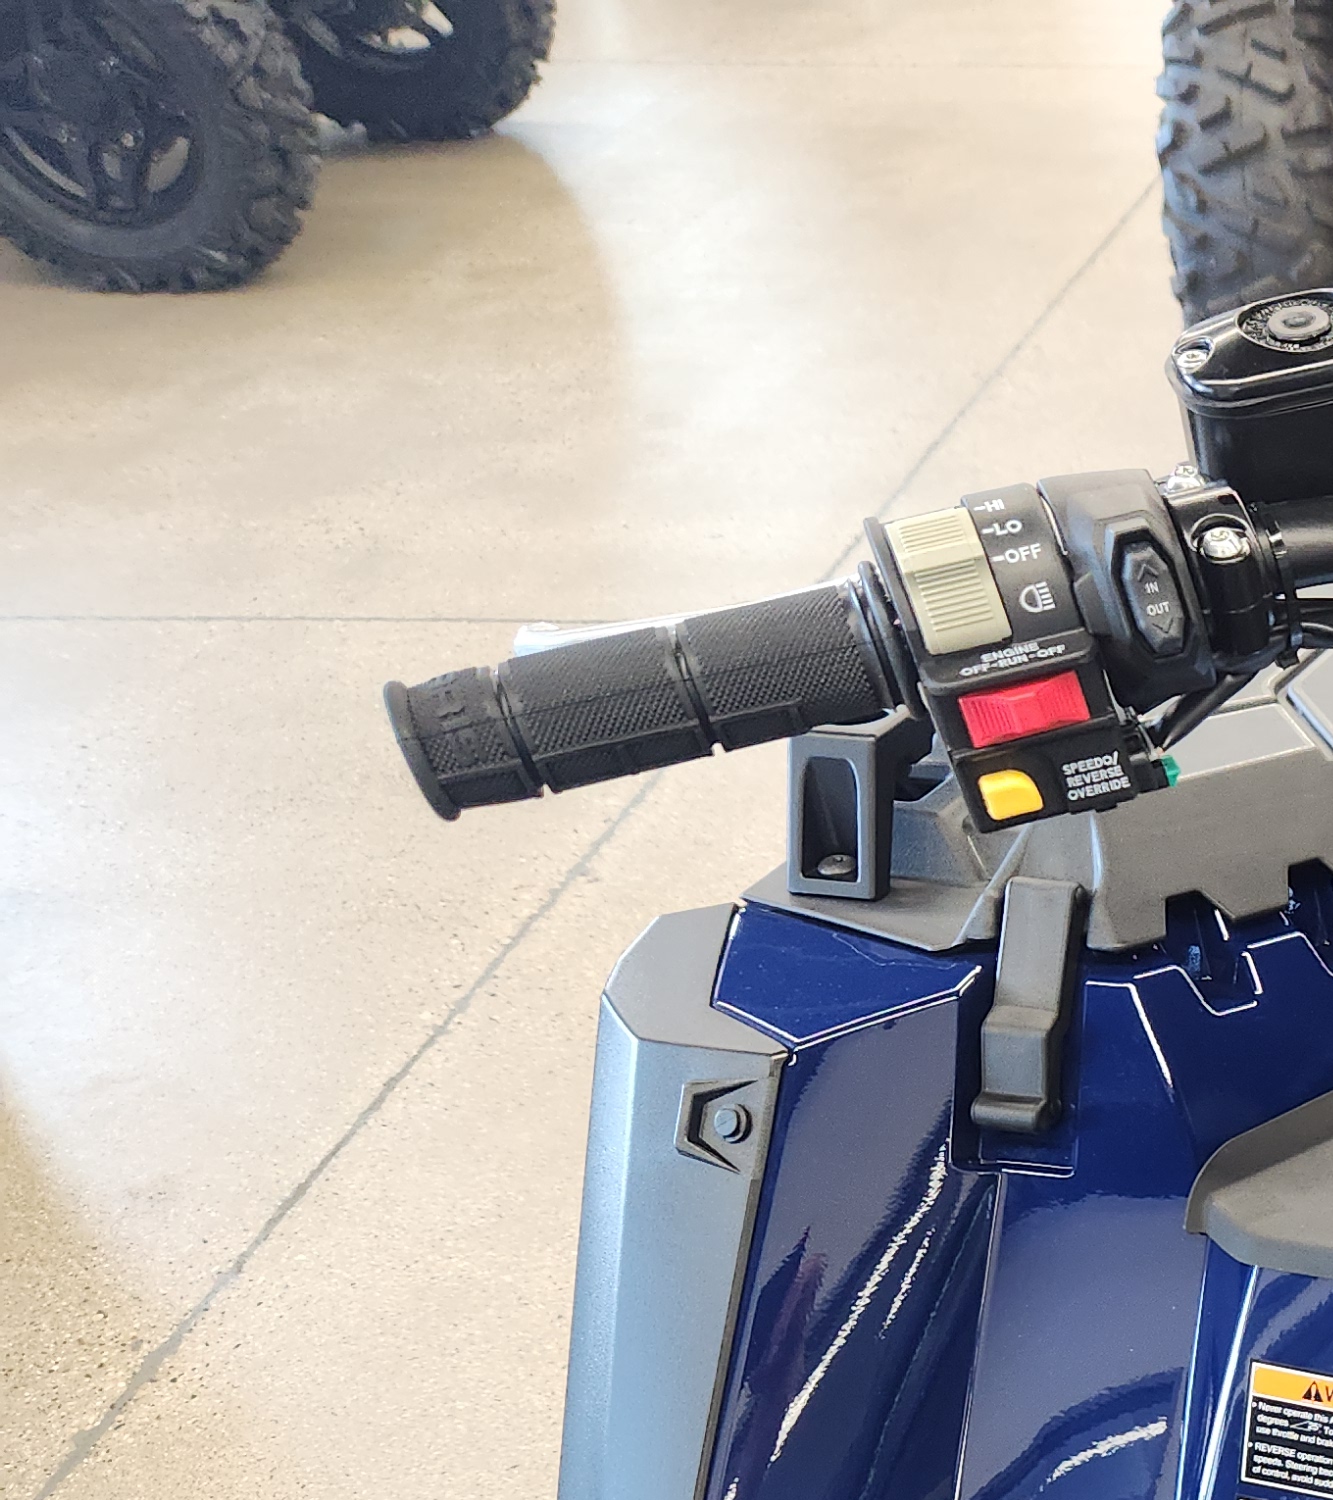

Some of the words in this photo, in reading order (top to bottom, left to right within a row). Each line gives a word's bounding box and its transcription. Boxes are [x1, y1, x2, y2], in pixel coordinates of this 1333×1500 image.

[1145, 580, 1159, 595] IN
[1146, 600, 1170, 616] OUT
[980, 642, 1040, 664] ENGINE
[1062, 750, 1120, 776] SPEEDO/
[1066, 765, 1124, 788] REVERSE
[1067, 777, 1131, 801] OVERRIDE
[1254, 1442, 1296, 1458] REVERSE
